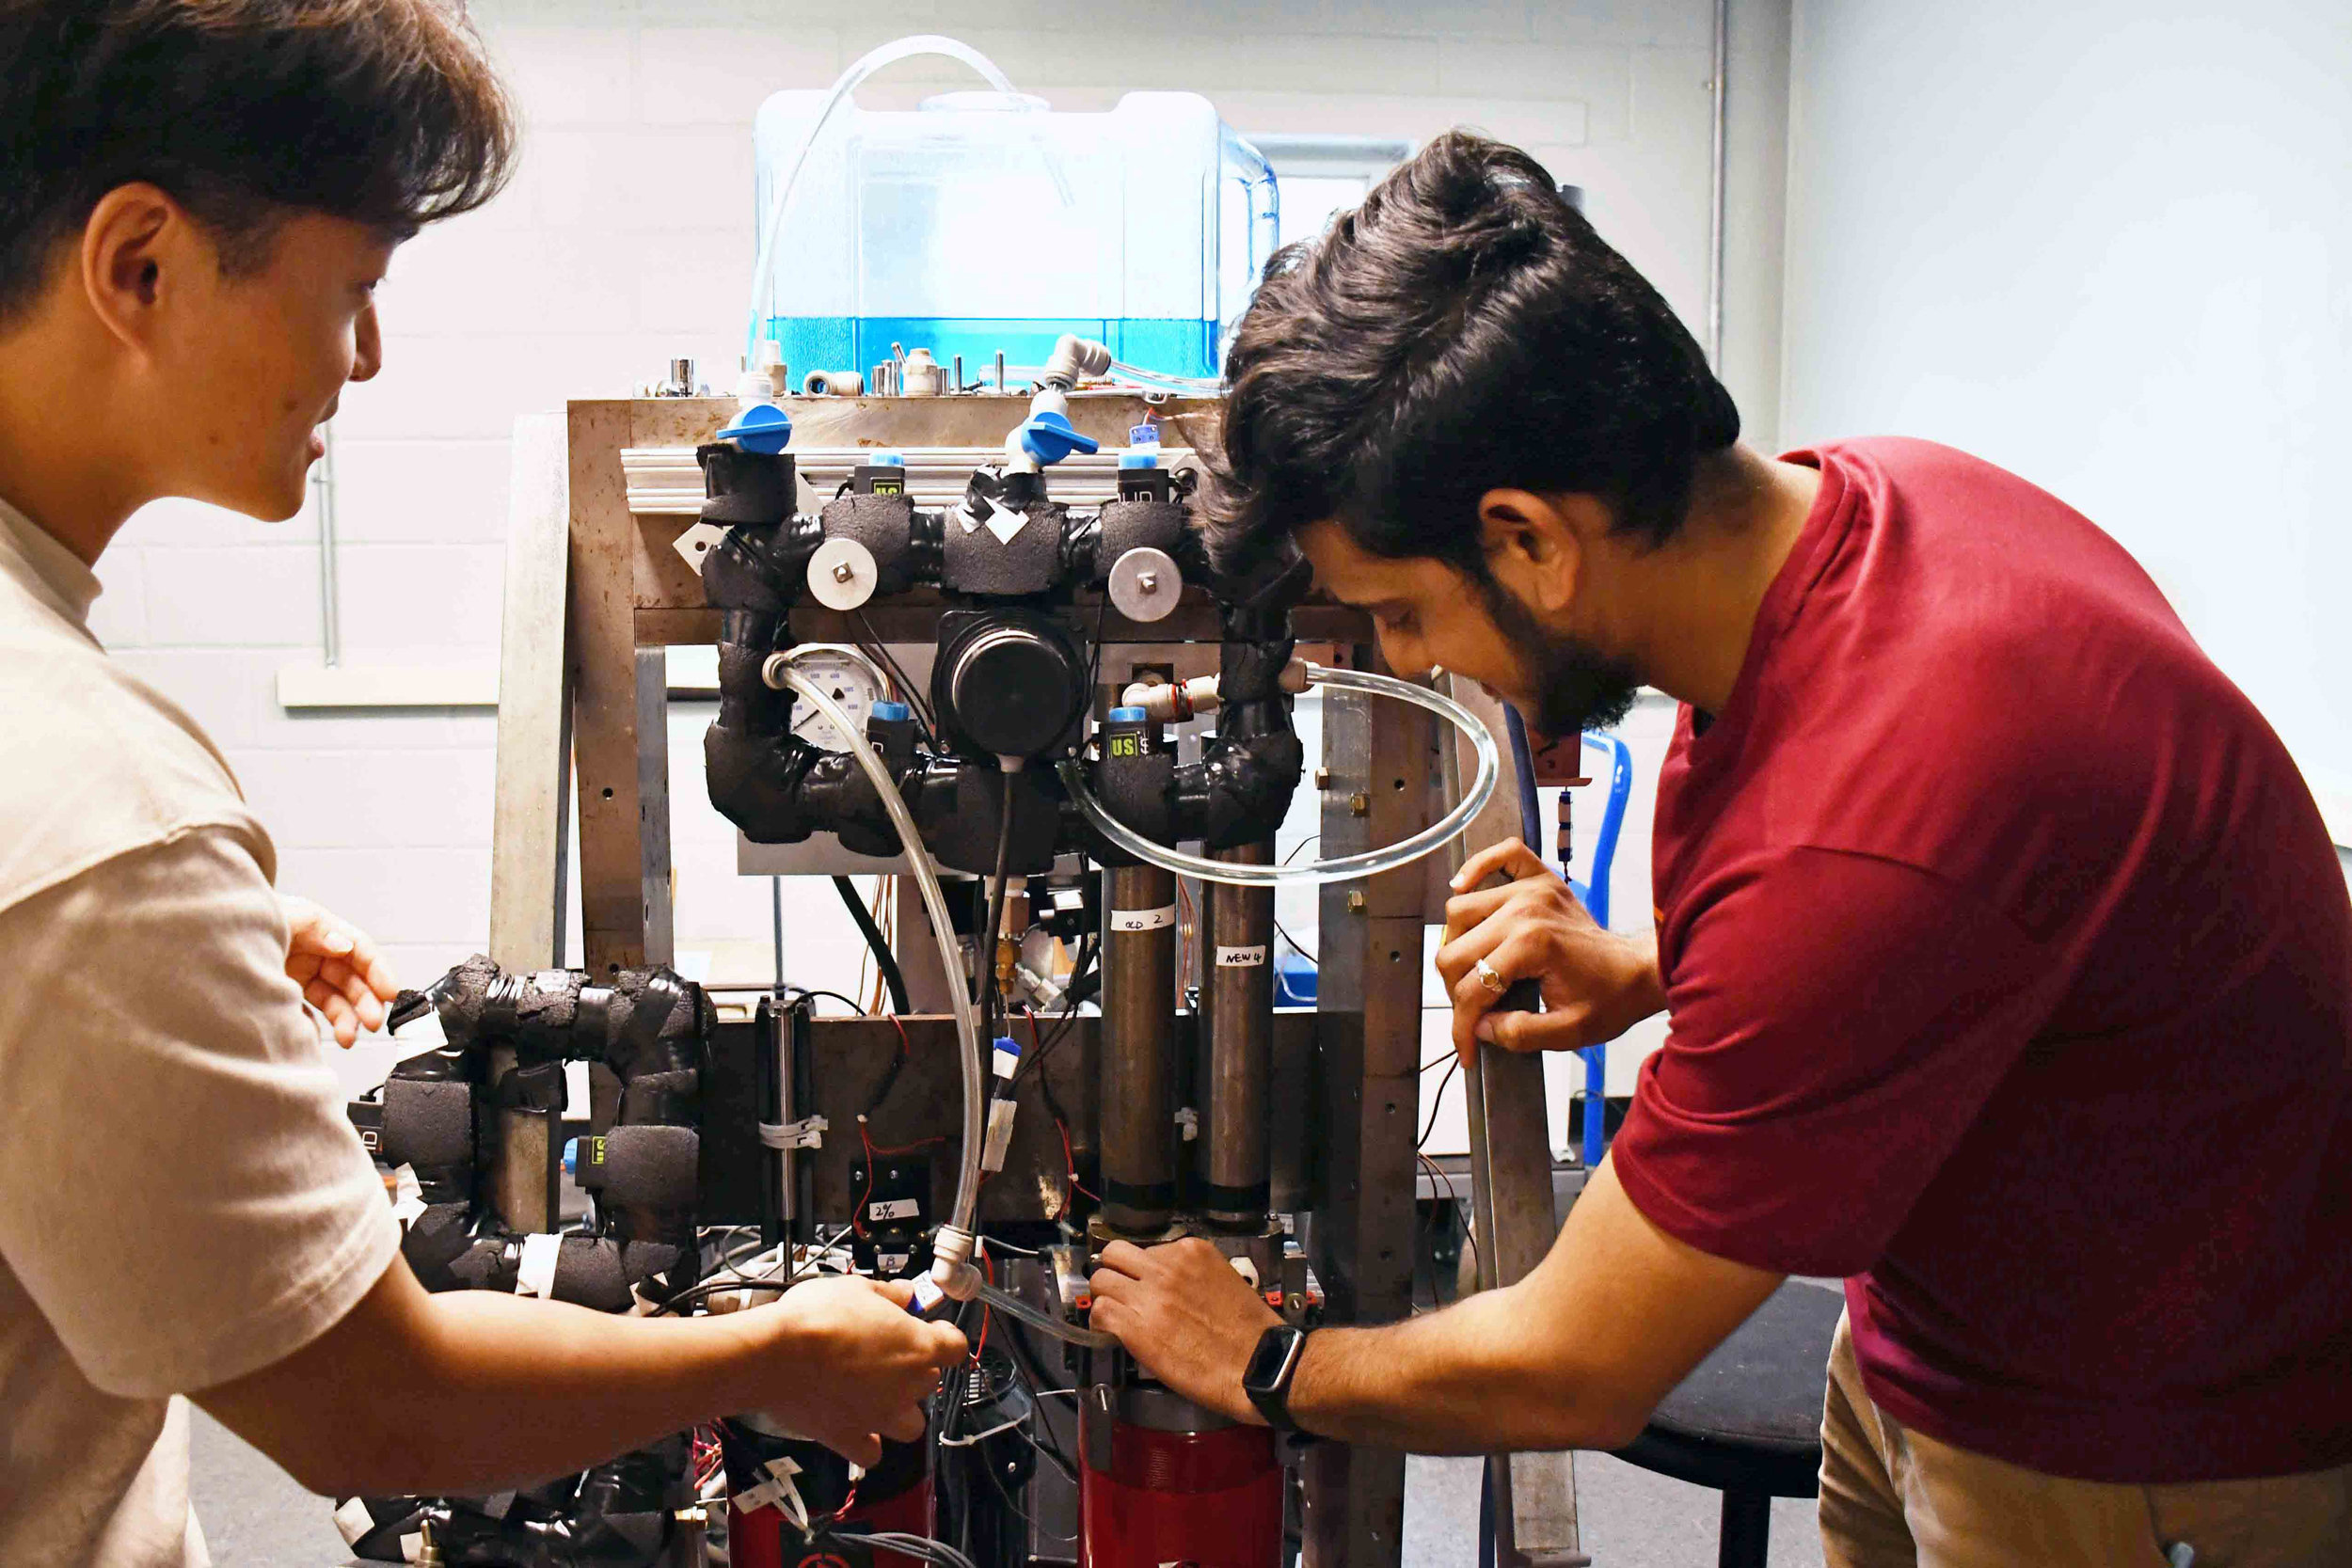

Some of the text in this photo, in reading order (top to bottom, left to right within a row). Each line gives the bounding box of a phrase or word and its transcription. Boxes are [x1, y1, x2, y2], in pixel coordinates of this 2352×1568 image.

[1111, 738, 1135, 756] US
[1125, 914, 1164, 930] OLD 2
[1226, 953, 1262, 964] NEW 4
[876, 1203, 895, 1219] 2%
